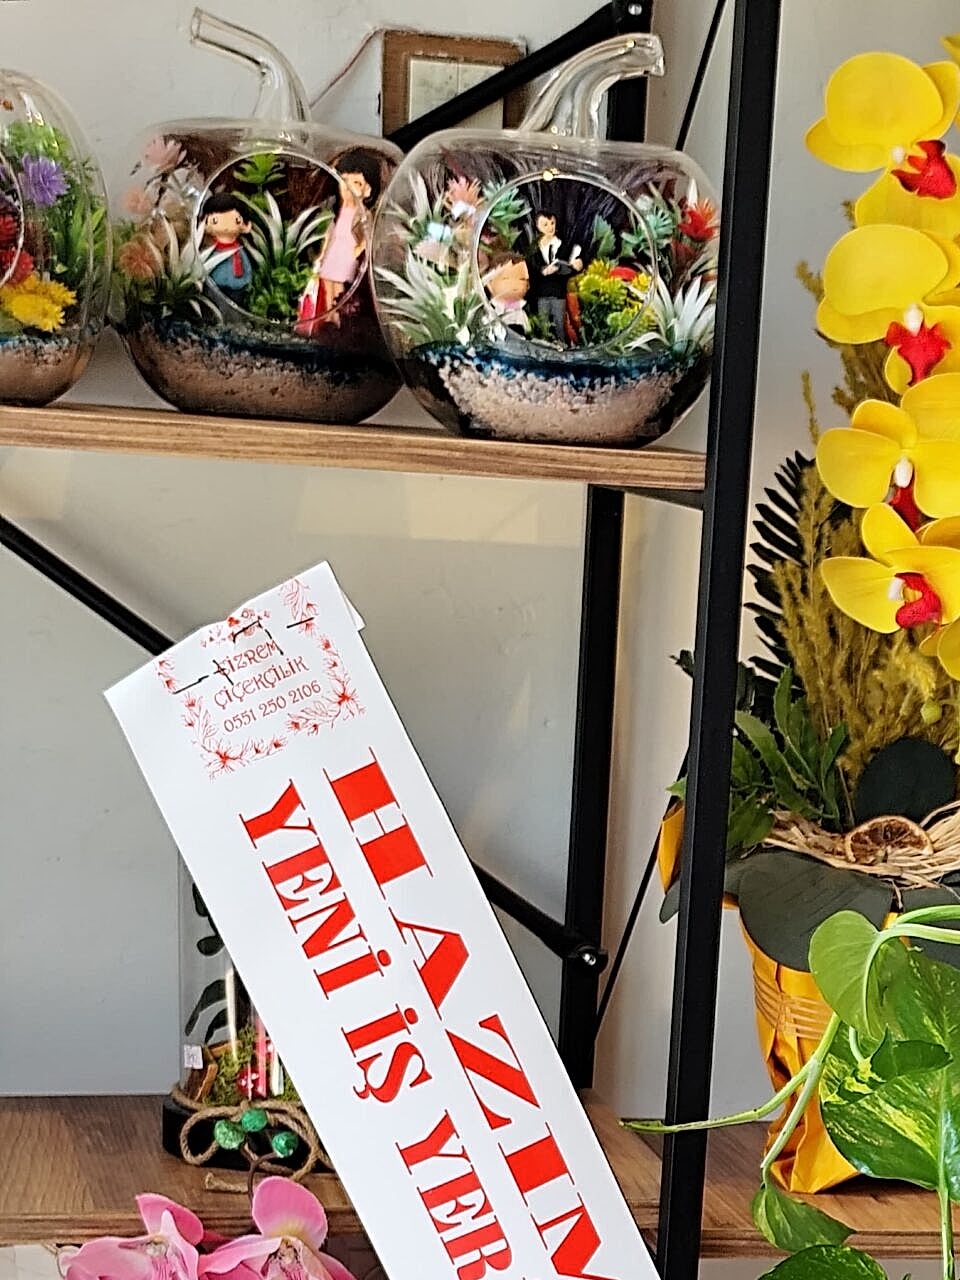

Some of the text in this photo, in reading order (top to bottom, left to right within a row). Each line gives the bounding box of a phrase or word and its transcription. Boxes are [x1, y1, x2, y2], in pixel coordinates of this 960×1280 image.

[214, 655, 310, 710] ÇİÇEKÇİLİK
[223, 680, 322, 734] 0551 250 2106
[240, 779, 393, 1001] YENİ
[341, 1004, 432, 1104] İŞ
